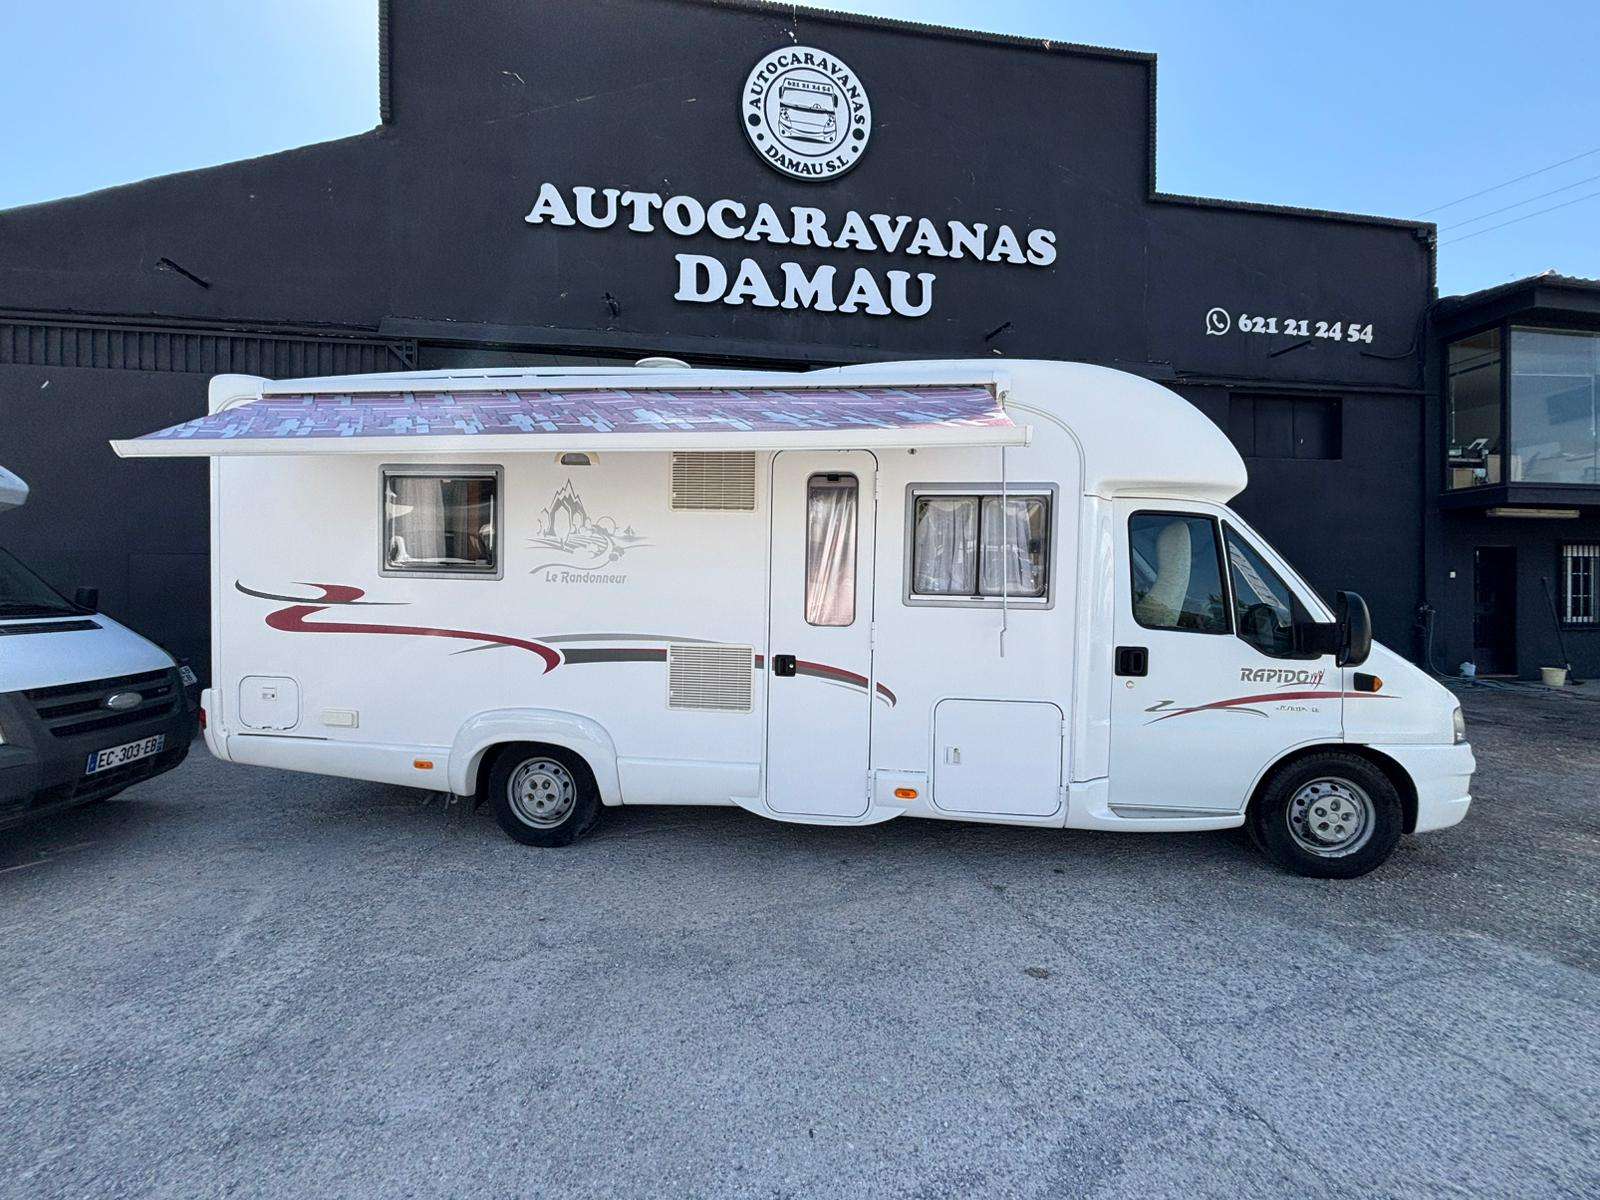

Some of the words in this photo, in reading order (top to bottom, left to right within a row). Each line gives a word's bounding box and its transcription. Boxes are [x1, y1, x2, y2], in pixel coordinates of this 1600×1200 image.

[749, 52, 866, 126] AUTOCARAVANAS
[764, 144, 824, 175] DAMAU
[524, 182, 1058, 267] AUTOCARAVANAS
[673, 253, 937, 318] DAMAU
[1238, 313, 1279, 334] 621
[1283, 318, 1310, 337] 21
[1315, 321, 1343, 342] 24
[1347, 323, 1374, 344] 54
[545, 570, 559, 583] Le
[560, 571, 627, 584] Randonneur
[97, 738, 159, 769] EC-303-EB
